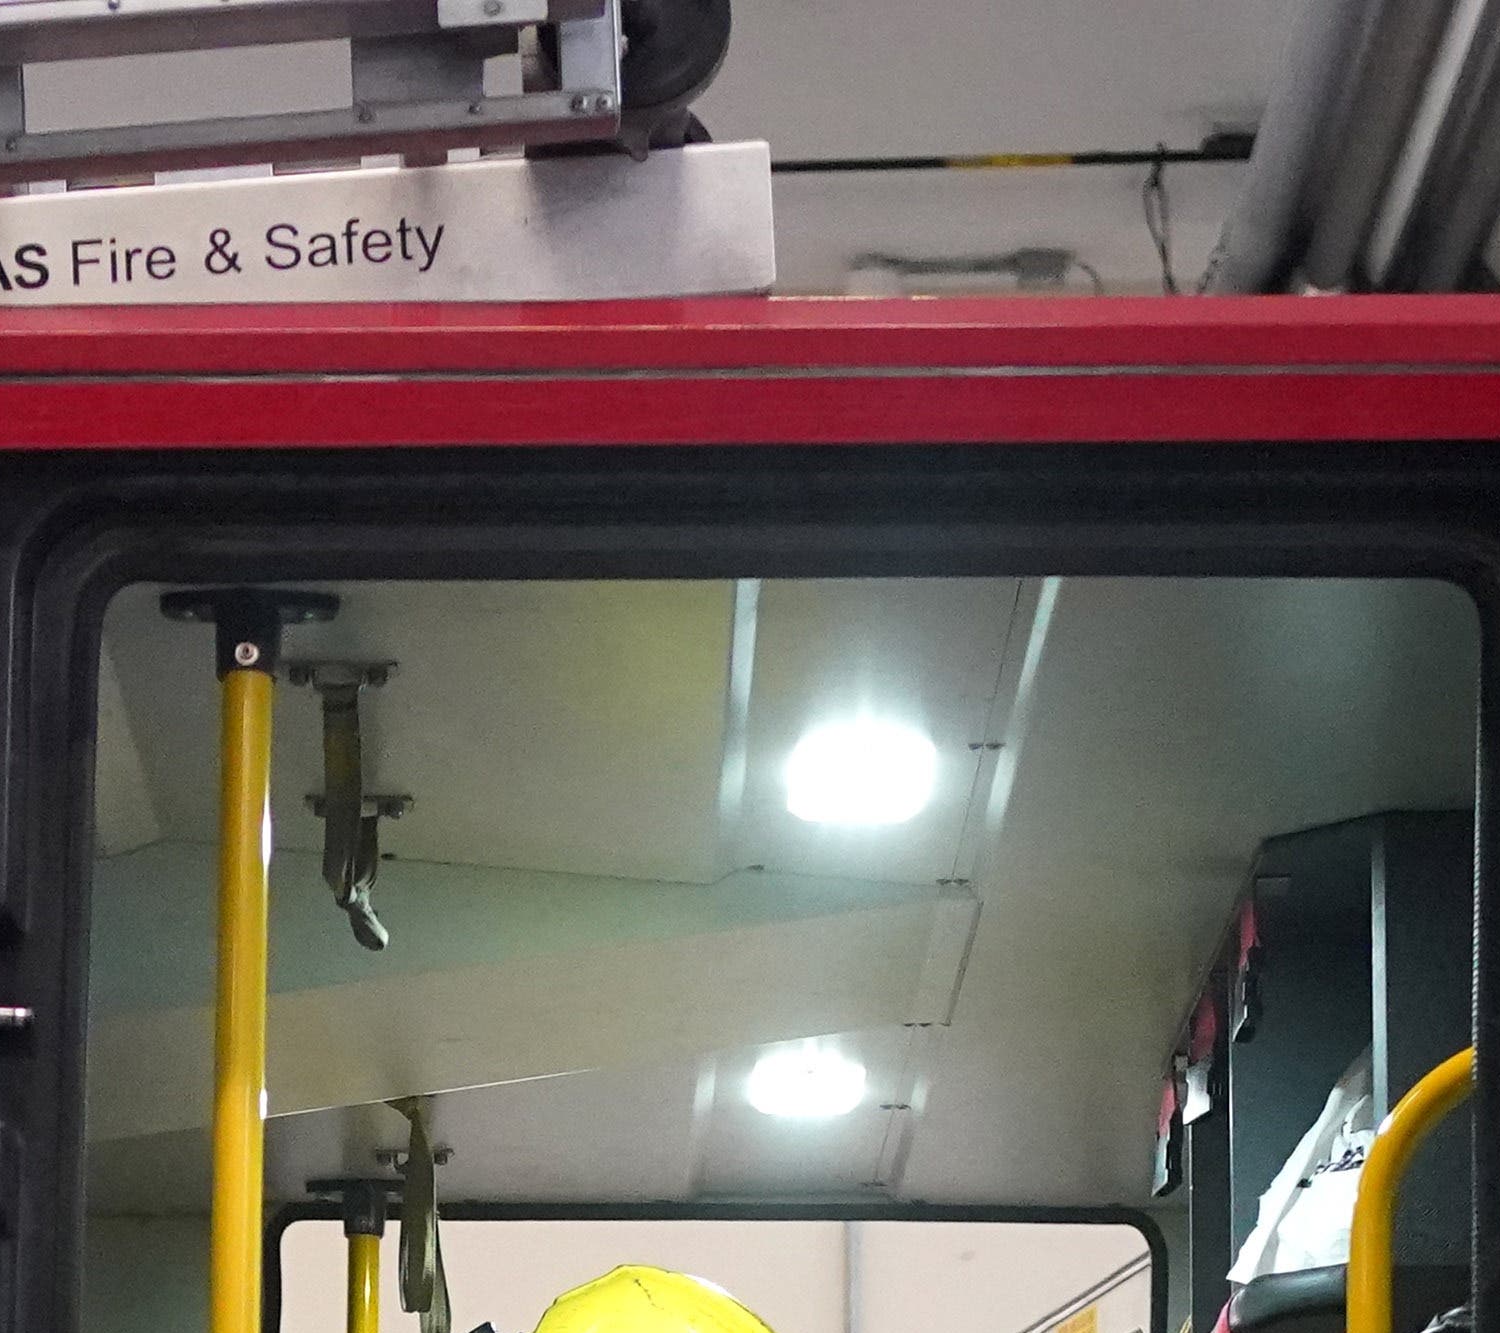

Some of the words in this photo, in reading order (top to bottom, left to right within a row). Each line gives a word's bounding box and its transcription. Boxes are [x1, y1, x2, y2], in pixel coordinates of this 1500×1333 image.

[71, 237, 177, 286] Fire
[204, 227, 242, 275] &
[264, 217, 446, 273] Safety
